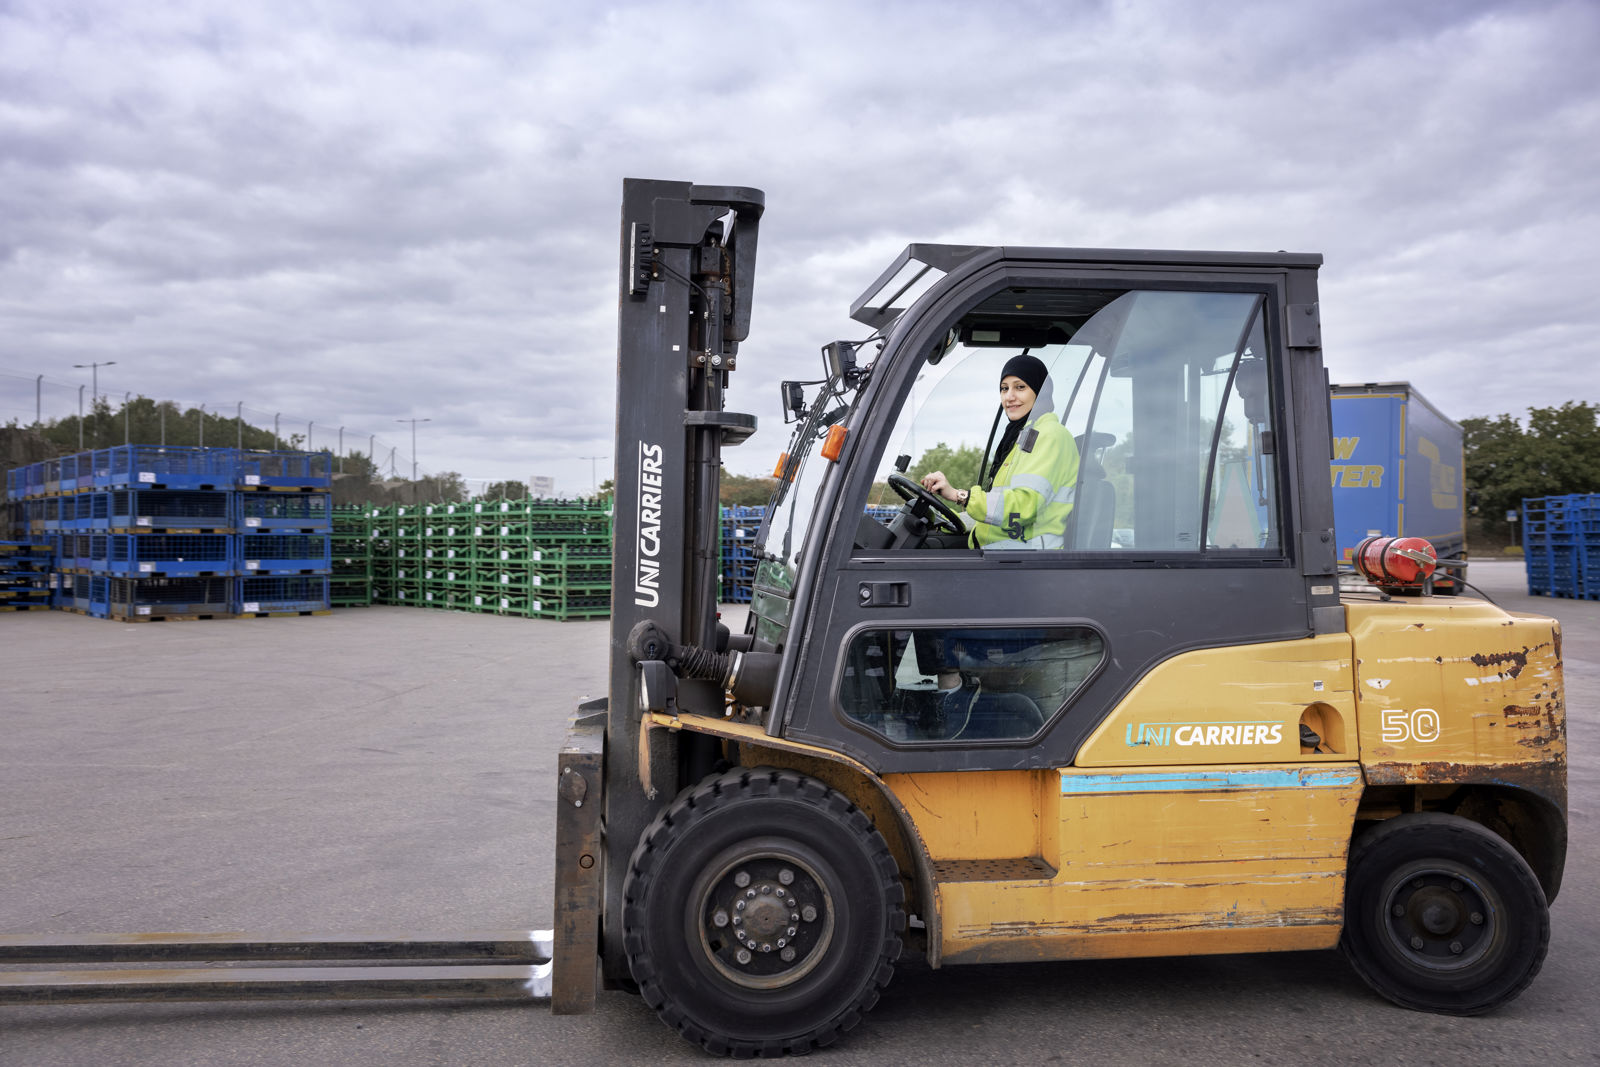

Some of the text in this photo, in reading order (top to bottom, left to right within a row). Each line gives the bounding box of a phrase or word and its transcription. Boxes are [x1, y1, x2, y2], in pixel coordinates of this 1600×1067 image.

[635, 440, 663, 608] UNICARRIERS
[1008, 512, 1021, 540] 5
[1125, 721, 1284, 747] UNICARRIERS
[1381, 708, 1440, 743] 50
